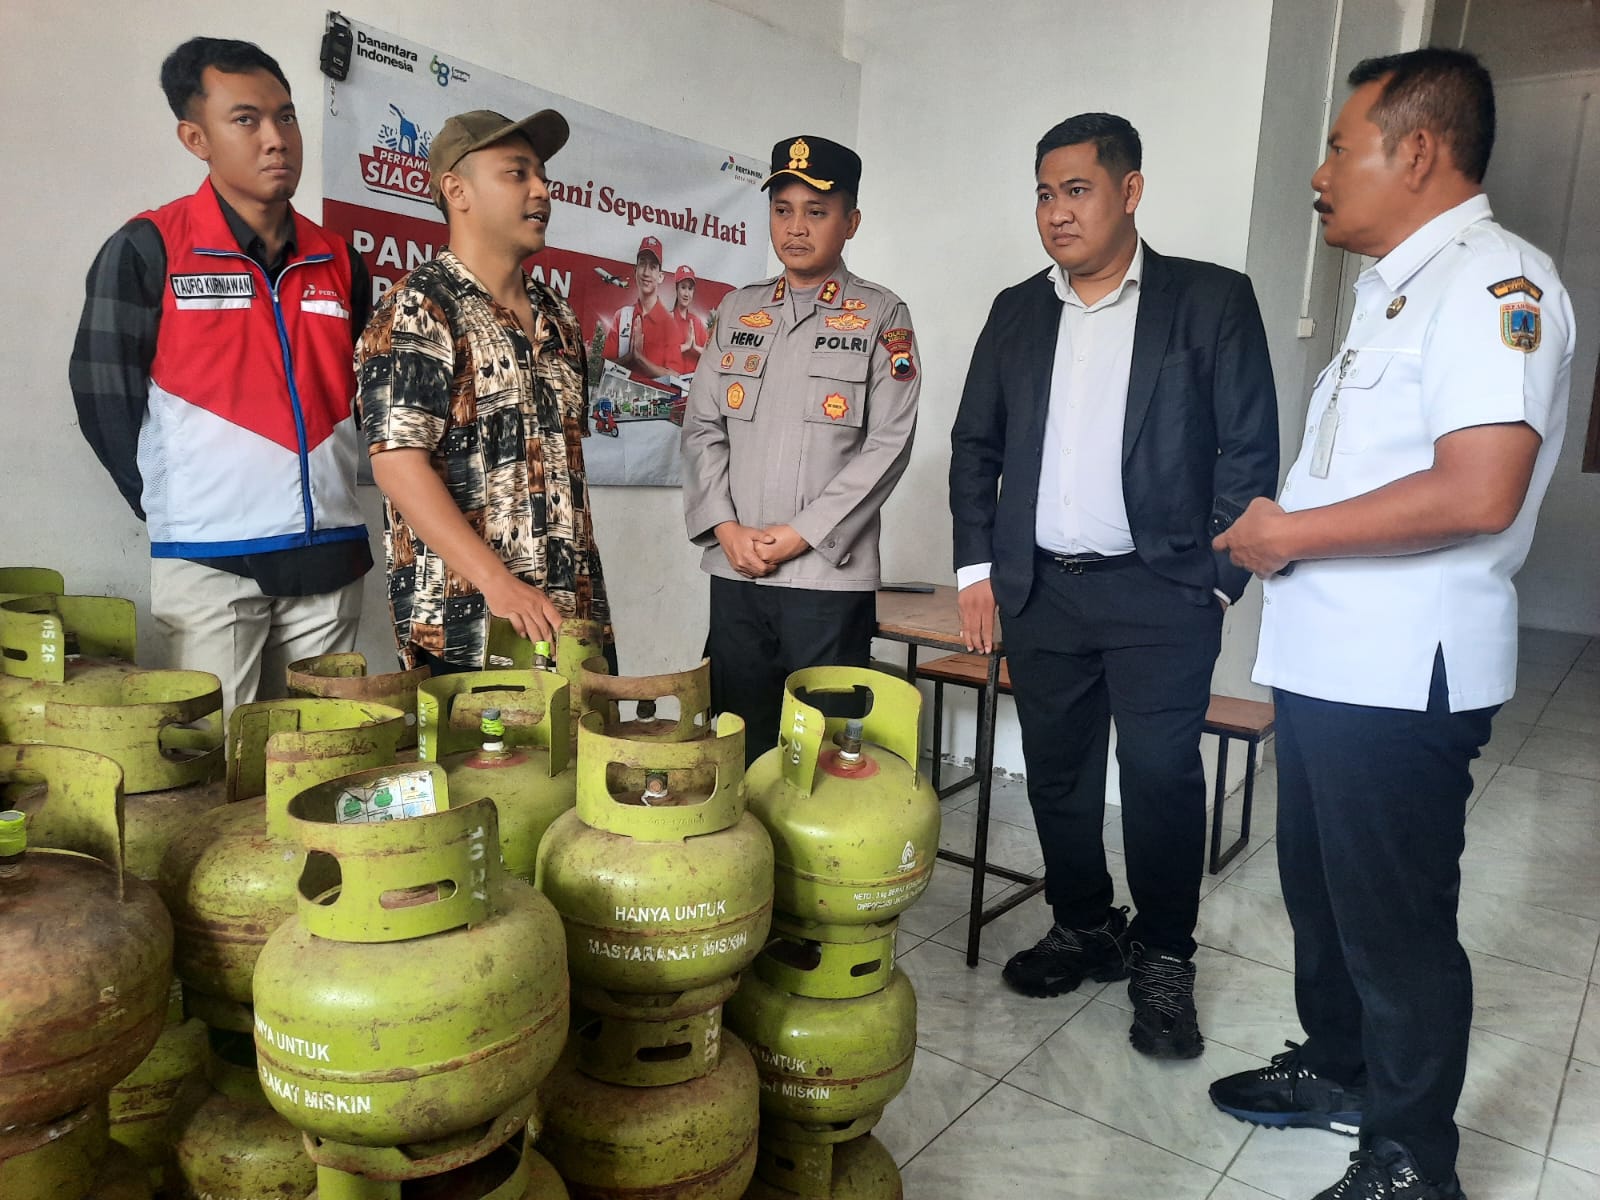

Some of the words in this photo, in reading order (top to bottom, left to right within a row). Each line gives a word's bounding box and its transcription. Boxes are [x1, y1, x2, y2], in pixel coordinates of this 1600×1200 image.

[357, 31, 418, 62] Danantara
[356, 44, 414, 73] Indonesia
[597, 186, 698, 234] Sepenuh
[701, 213, 747, 246] Hati
[174, 277, 205, 295] TAUFIQ
[204, 276, 251, 294] KURNIAWAN
[730, 331, 765, 347] HERU
[815, 336, 868, 353] POLRI
[41, 644, 56, 663] 26
[615, 906, 671, 922] HANYA
[675, 900, 726, 921] UNTUK
[588, 938, 698, 962] MASYARAKAT
[703, 931, 747, 957] MISKIN
[276, 1031, 330, 1062] UNTUK
[761, 1050, 806, 1073] UNTUK
[304, 1089, 371, 1114] MISKIN
[782, 1083, 830, 1100] MISKIN
